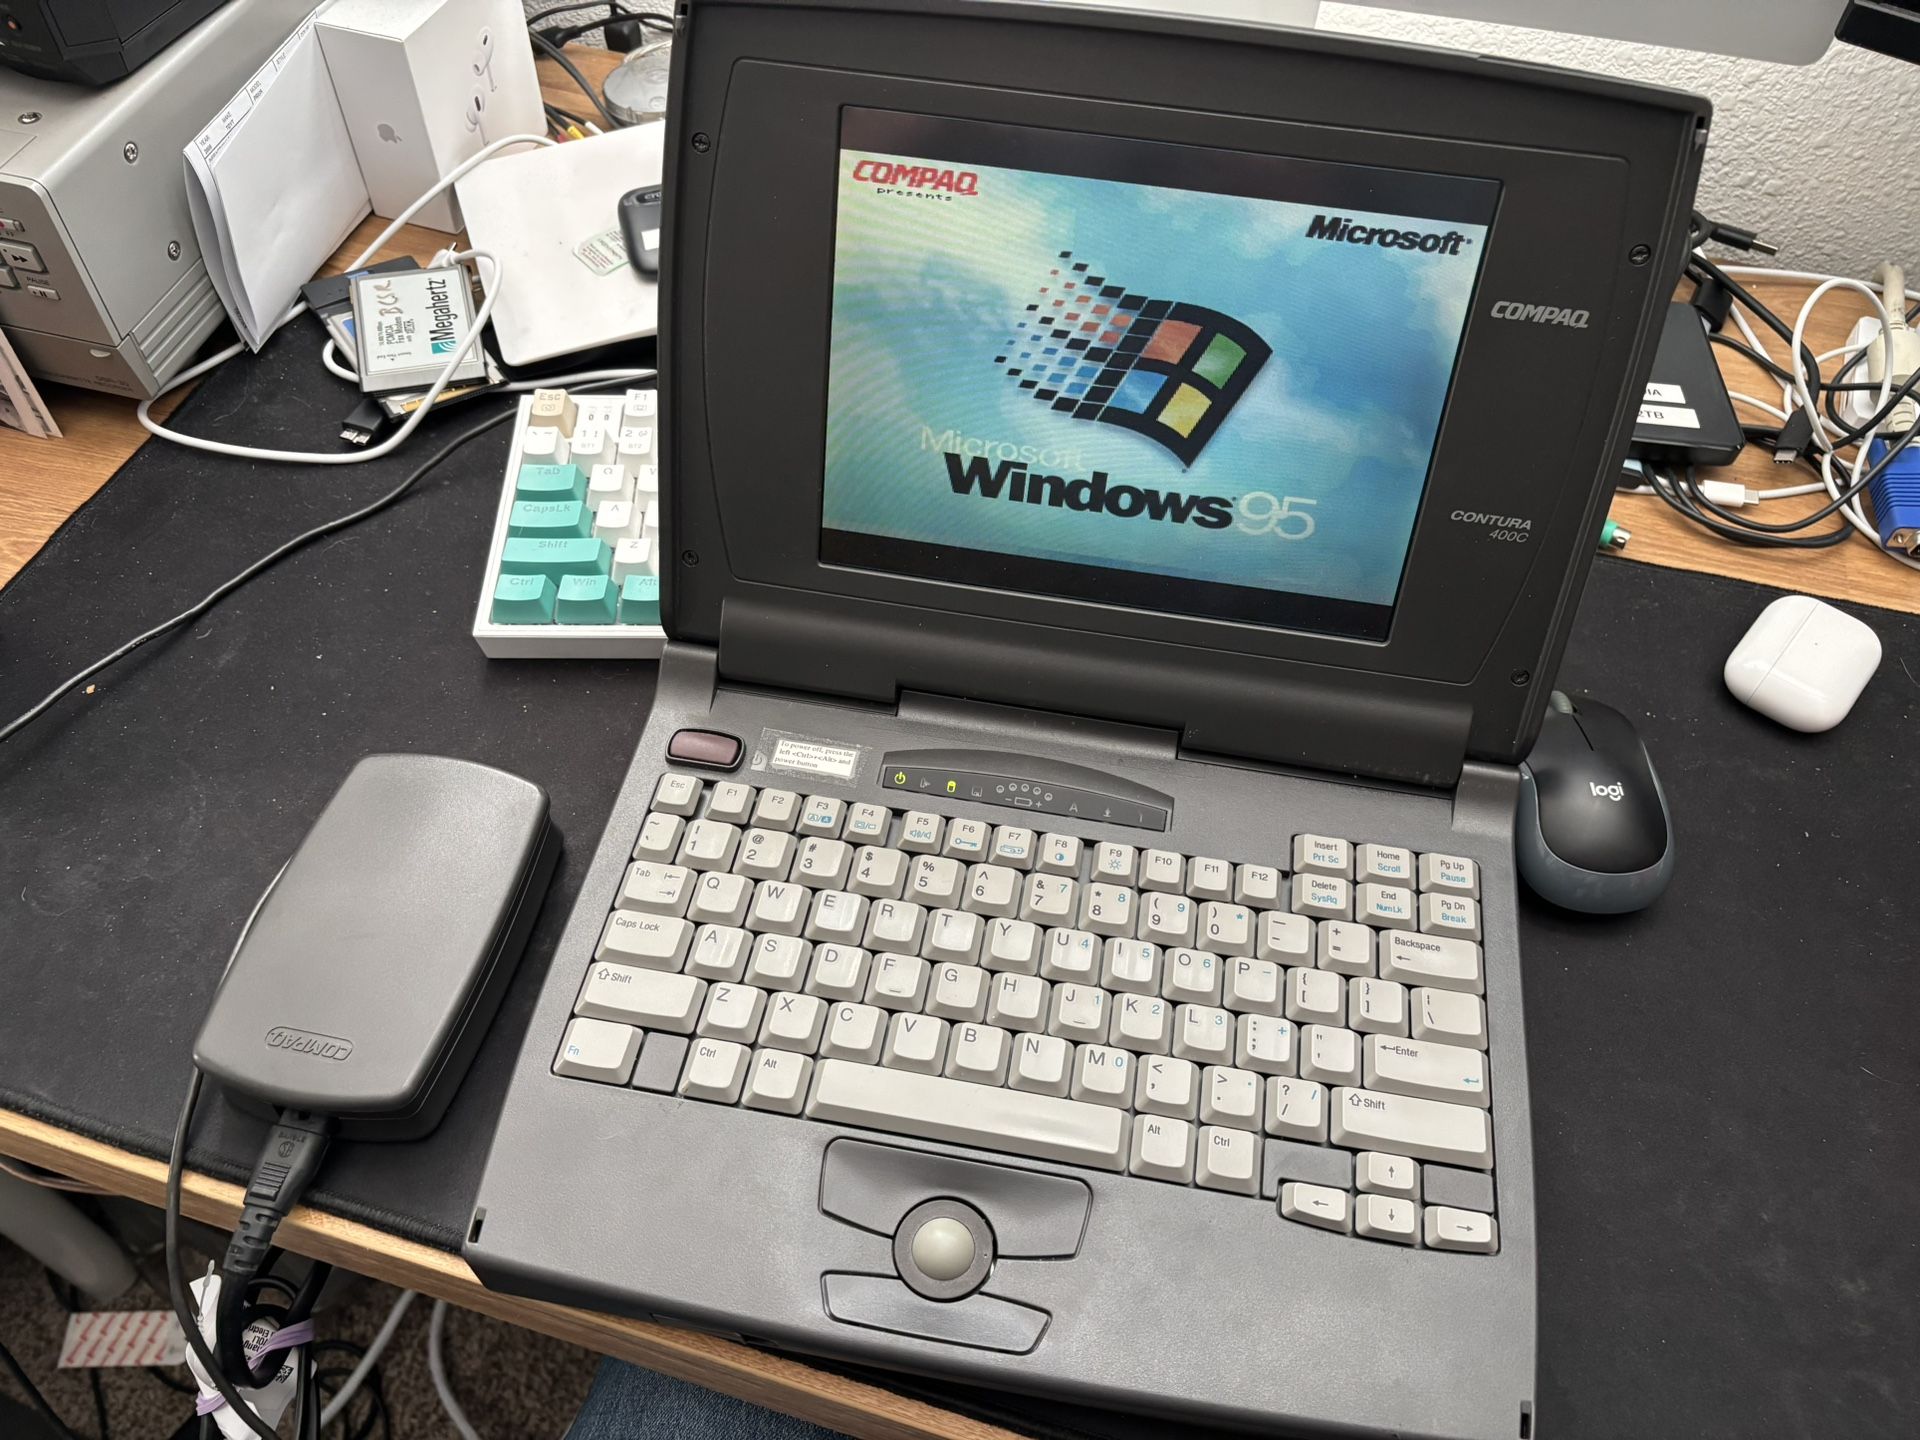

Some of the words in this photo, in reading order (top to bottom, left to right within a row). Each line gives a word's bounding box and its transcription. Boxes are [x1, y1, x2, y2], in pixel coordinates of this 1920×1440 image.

[853, 160, 978, 196] COMPAQ
[877, 188, 953, 202] presents
[425, 278, 458, 342] Megahertz
[1490, 300, 1590, 328] COMPAQ
[921, 426, 1088, 471] Microsoft
[944, 452, 1234, 530] Windows
[1238, 491, 1317, 540] 95
[1450, 510, 1532, 531] CONTURA
[1488, 529, 1530, 543] 400C
[670, 780, 686, 789] Esc
[726, 788, 738, 796] F1
[1590, 782, 1624, 801] logi
[772, 796, 784, 804] F2
[816, 802, 828, 810] F3
[862, 808, 875, 818] F4
[916, 817, 929, 826] F5
[962, 824, 975, 833] F6
[752, 834, 765, 844] @
[1008, 832, 1021, 841] F7
[691, 840, 696, 850] 1
[808, 844, 818, 852] #
[1055, 839, 1068, 848] F8
[1314, 840, 1338, 852] Insert
[746, 850, 758, 860] 2
[865, 852, 874, 861] $
[1109, 848, 1122, 857] F9
[1313, 852, 1325, 862] Prt
[1328, 854, 1339, 864] Sc
[1377, 850, 1400, 861] Home
[804, 858, 813, 868] 3
[922, 861, 935, 872] %
[1154, 856, 1172, 866] F10
[1440, 860, 1450, 870] Pg
[1453, 861, 1464, 872] Up
[636, 868, 650, 878] Tab
[862, 868, 870, 878] 4
[1204, 864, 1219, 874] F11
[1378, 863, 1402, 874] Scroll
[918, 876, 928, 888] 5
[1252, 871, 1268, 882] F12
[1440, 872, 1466, 884] Pause
[706, 876, 720, 890] Q
[1036, 880, 1046, 890] &
[1060, 884, 1068, 894] 7
[1312, 880, 1337, 892] Delete
[768, 884, 785, 900] W
[976, 886, 984, 896] 6
[1381, 890, 1396, 900] End
[824, 894, 836, 908] E
[1034, 894, 1044, 906] 7
[1118, 894, 1126, 902] 8
[1311, 892, 1338, 905] SysRq
[880, 904, 894, 917] R
[1092, 904, 1102, 916] 8
[1177, 903, 1185, 912] 9
[1442, 900, 1452, 910] Pg
[1454, 902, 1466, 911] Dn
[616, 916, 636, 930] Caps
[640, 920, 660, 932] Lock
[942, 914, 953, 926] T
[1152, 914, 1160, 925] 9
[1442, 912, 1467, 924] Break
[1000, 922, 1012, 937] Y
[1210, 923, 1220, 935] 0
[705, 930, 718, 944] A
[1058, 932, 1070, 946] U
[765, 940, 778, 952] S
[1080, 939, 1088, 949] 4
[1394, 936, 1441, 952] Backspace
[824, 949, 838, 963] D
[1142, 948, 1150, 958] 5
[884, 958, 896, 972] F
[1178, 954, 1191, 966] O
[1203, 958, 1211, 968] 6
[1238, 962, 1250, 974] P
[611, 973, 632, 984] Shift
[945, 968, 958, 982] G
[1004, 977, 1017, 992] H
[716, 988, 731, 1002] Z
[1066, 990, 1076, 1002] J
[780, 997, 795, 1012] X
[1126, 998, 1138, 1014] K
[1152, 1004, 1160, 1014] 2
[840, 1008, 854, 1022] C
[1188, 1009, 1198, 1024] L
[1215, 1016, 1223, 1026] 3
[904, 1018, 918, 1032] V
[964, 1028, 977, 1042] B
[267, 1032, 352, 1061] COMPAQ
[568, 1046, 580, 1056] Fn
[700, 1046, 716, 1058] Ctrl
[1026, 1038, 1040, 1054] N
[1395, 1046, 1419, 1058] Enter
[764, 1058, 778, 1070] Alt
[1088, 1050, 1106, 1066] M
[1282, 1084, 1290, 1096] ?
[1364, 1099, 1386, 1110] Shift
[1148, 1124, 1160, 1136] Alt
[1214, 1135, 1230, 1148] Ctrl
